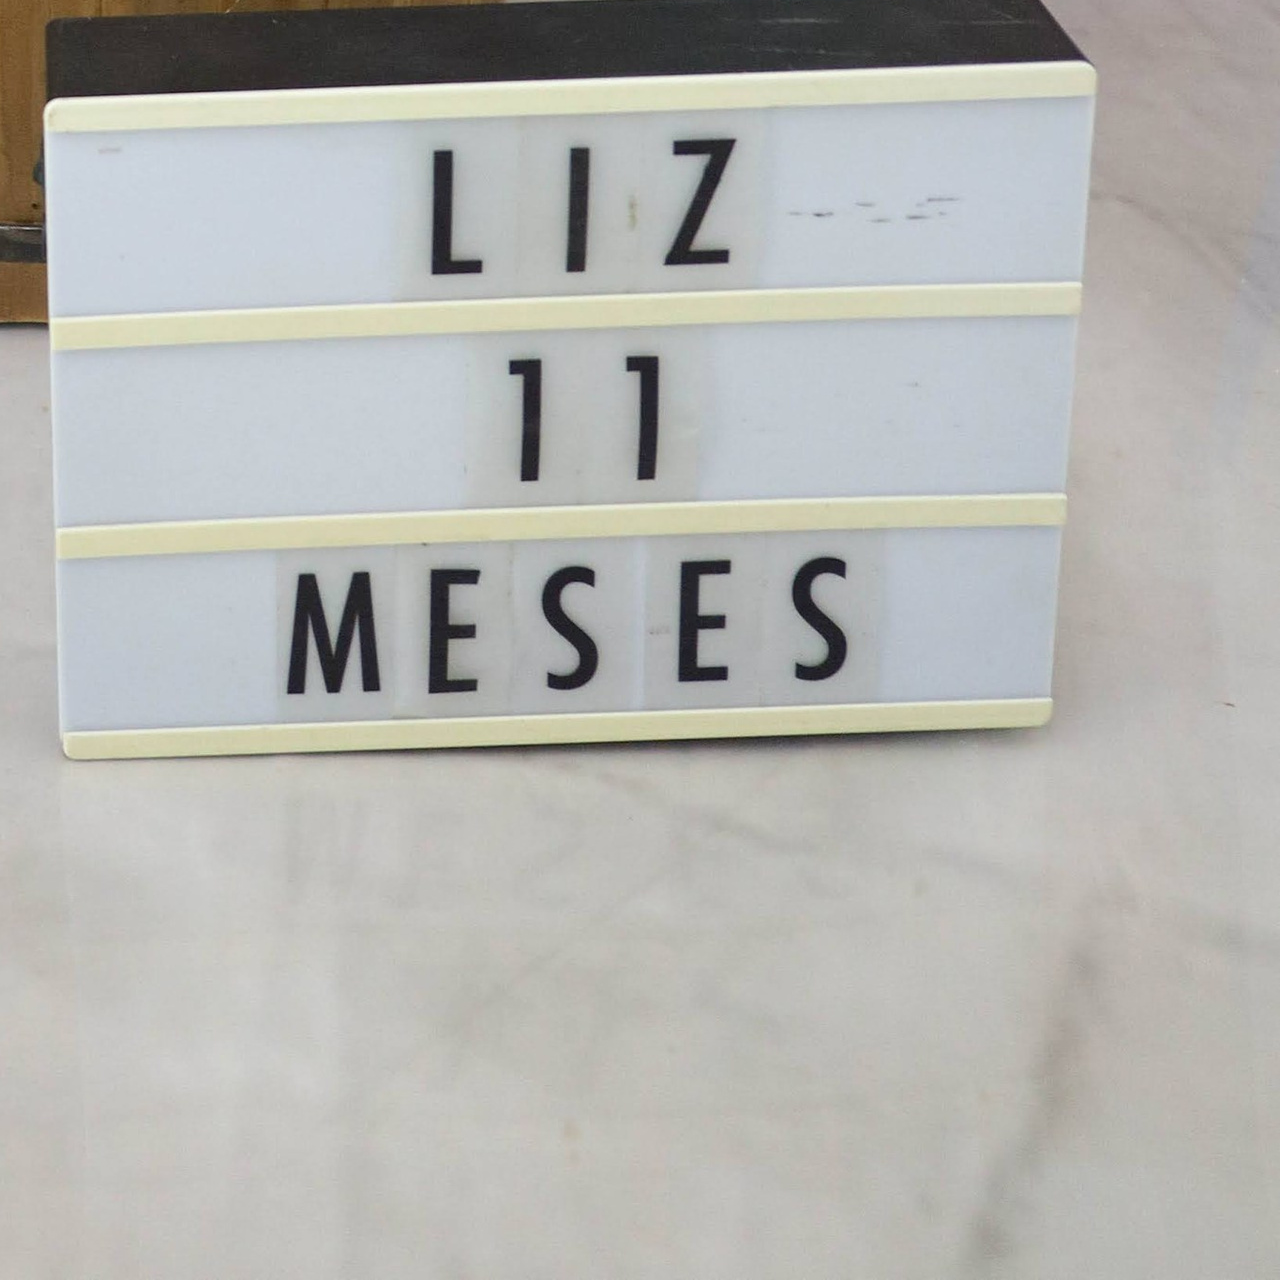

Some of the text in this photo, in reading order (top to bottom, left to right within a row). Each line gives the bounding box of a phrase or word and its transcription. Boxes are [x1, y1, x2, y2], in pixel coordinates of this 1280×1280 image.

[430, 138, 737, 275] LIZ
[508, 355, 660, 482] 11
[285, 556, 848, 695] MESES
